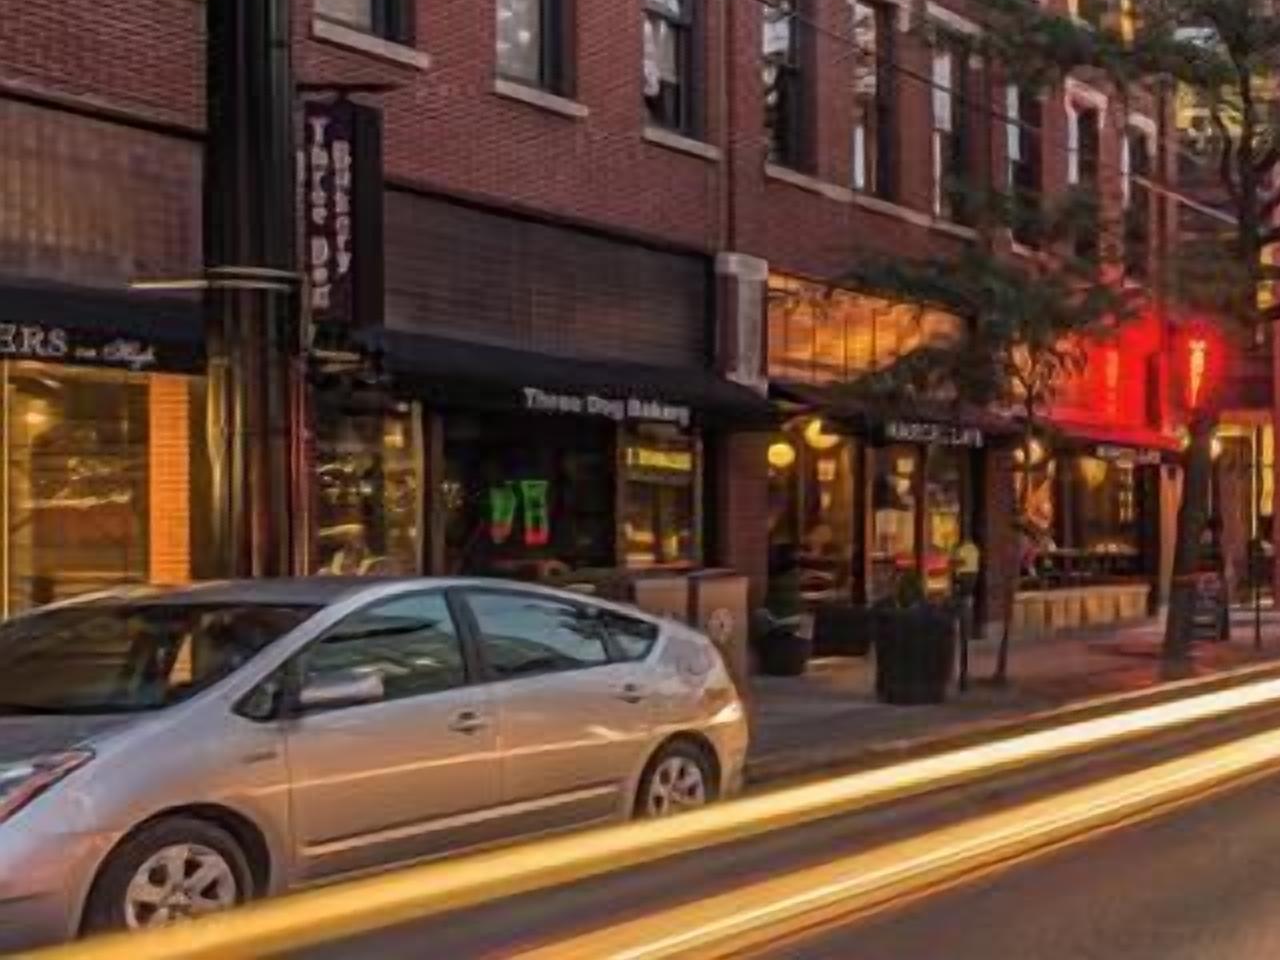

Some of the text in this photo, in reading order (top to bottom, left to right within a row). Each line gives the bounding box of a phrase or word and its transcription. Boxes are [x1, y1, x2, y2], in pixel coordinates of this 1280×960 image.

[522, 386, 692, 428] Three Dog Bakery
